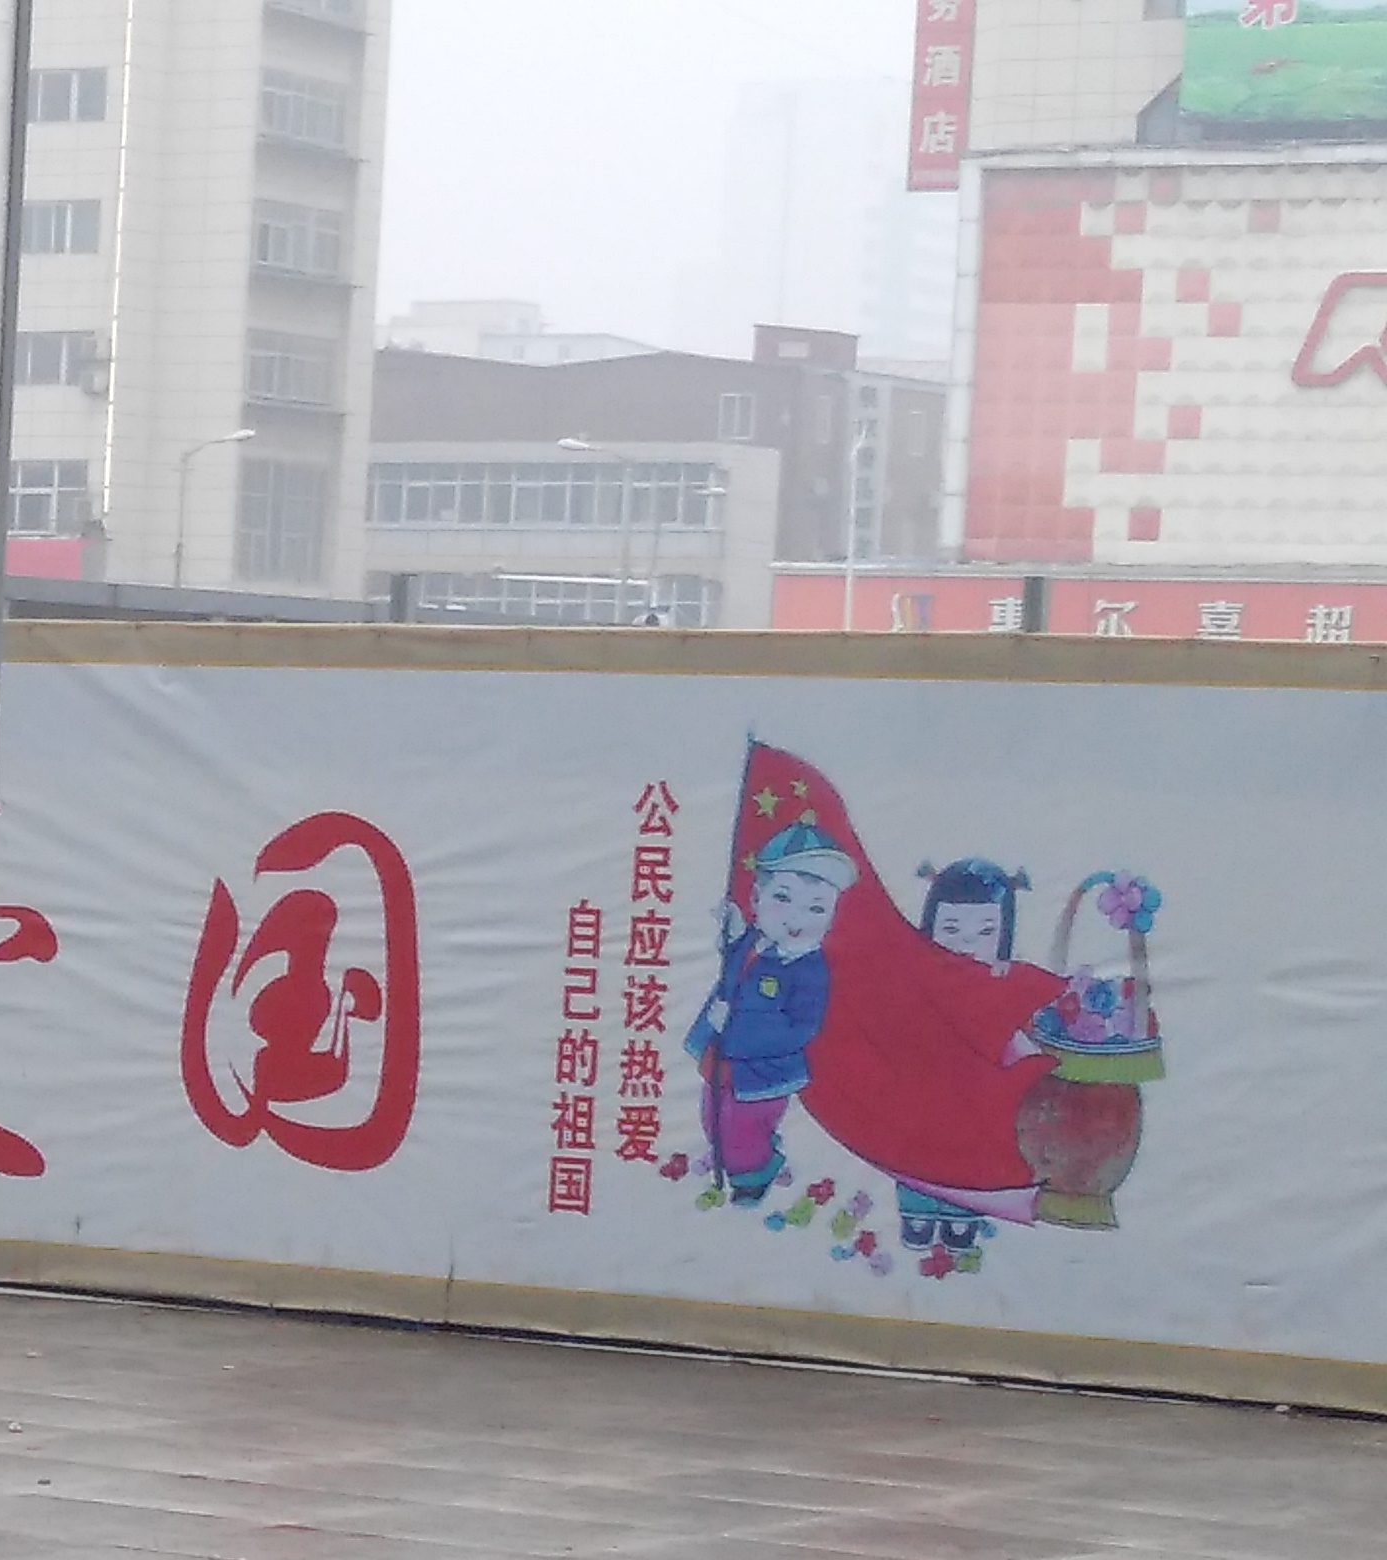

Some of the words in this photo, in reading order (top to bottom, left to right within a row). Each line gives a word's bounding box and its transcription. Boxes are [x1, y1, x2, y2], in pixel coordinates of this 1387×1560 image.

[547, 898, 603, 1216] 自己的祖国
[614, 780, 680, 1164] 公民应该热爱
